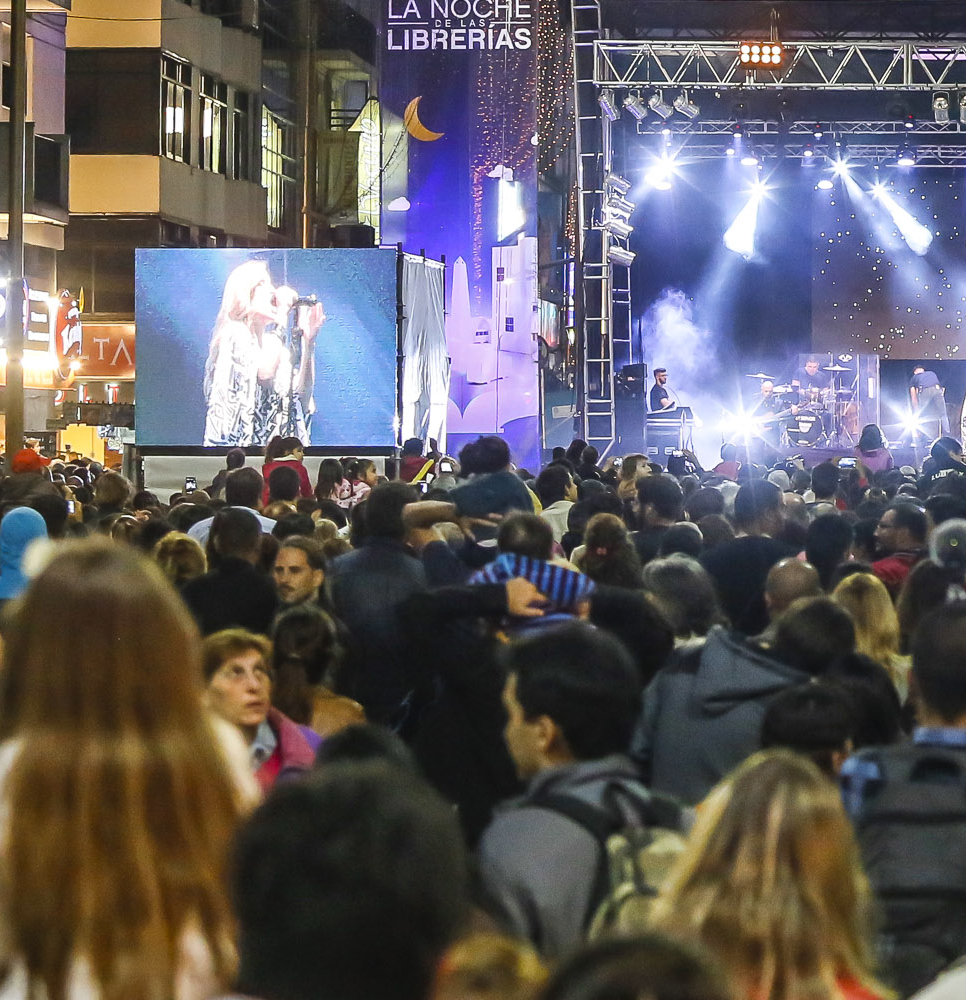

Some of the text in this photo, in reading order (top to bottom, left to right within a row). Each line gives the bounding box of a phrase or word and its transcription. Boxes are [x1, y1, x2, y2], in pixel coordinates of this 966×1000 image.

[435, 19, 486, 28] DE LAS
[387, 23, 532, 50] LIBRERÍAS
